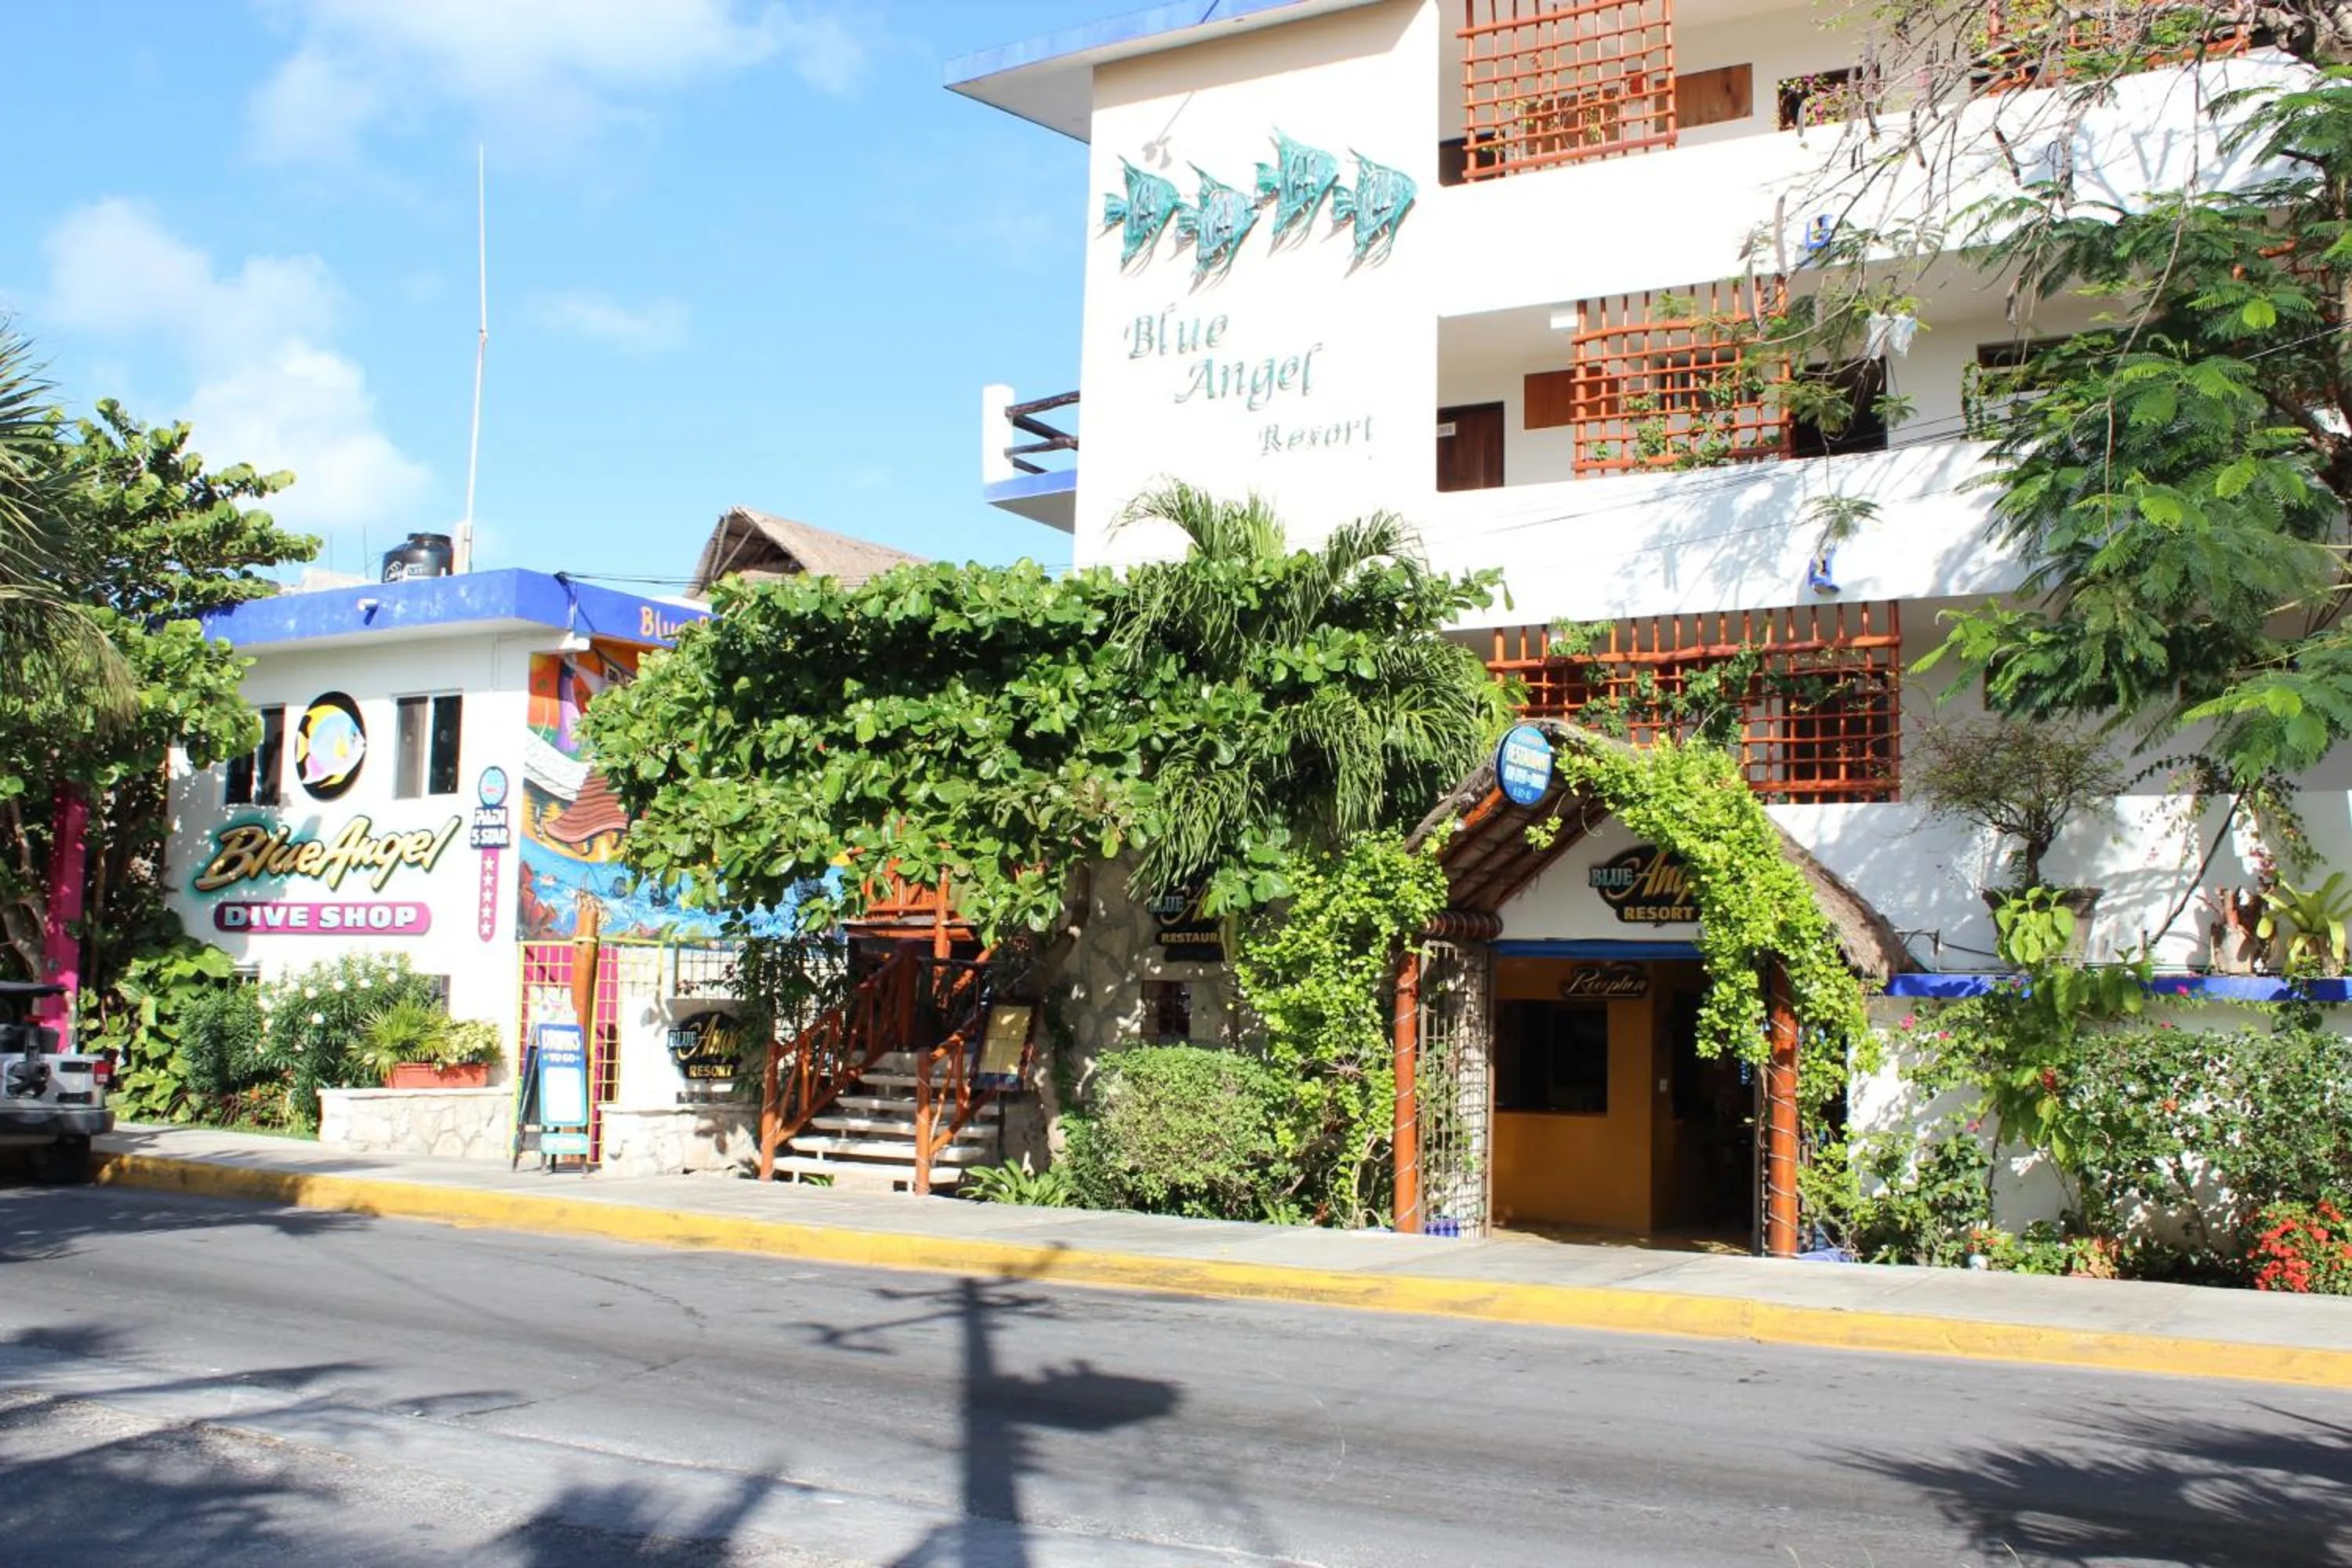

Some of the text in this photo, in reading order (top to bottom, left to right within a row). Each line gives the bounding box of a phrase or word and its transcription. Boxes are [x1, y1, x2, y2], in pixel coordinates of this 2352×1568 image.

[1123, 303, 1229, 359] Blue
[1174, 342, 1324, 412] Angel
[1258, 415, 1374, 456] Resort
[640, 604, 678, 641] Blu
[475, 808, 506, 826] PADI
[470, 828, 508, 844] 5 STAR
[194, 814, 463, 893] Blue Angel
[1592, 867, 1634, 887] BLUE
[224, 906, 418, 929] DIVE SHOP
[1624, 906, 1694, 920] RESORT
[1161, 932, 1221, 943] RESTAUR
[669, 1031, 697, 1047] BLUE
[689, 1065, 733, 1078] RESORT
